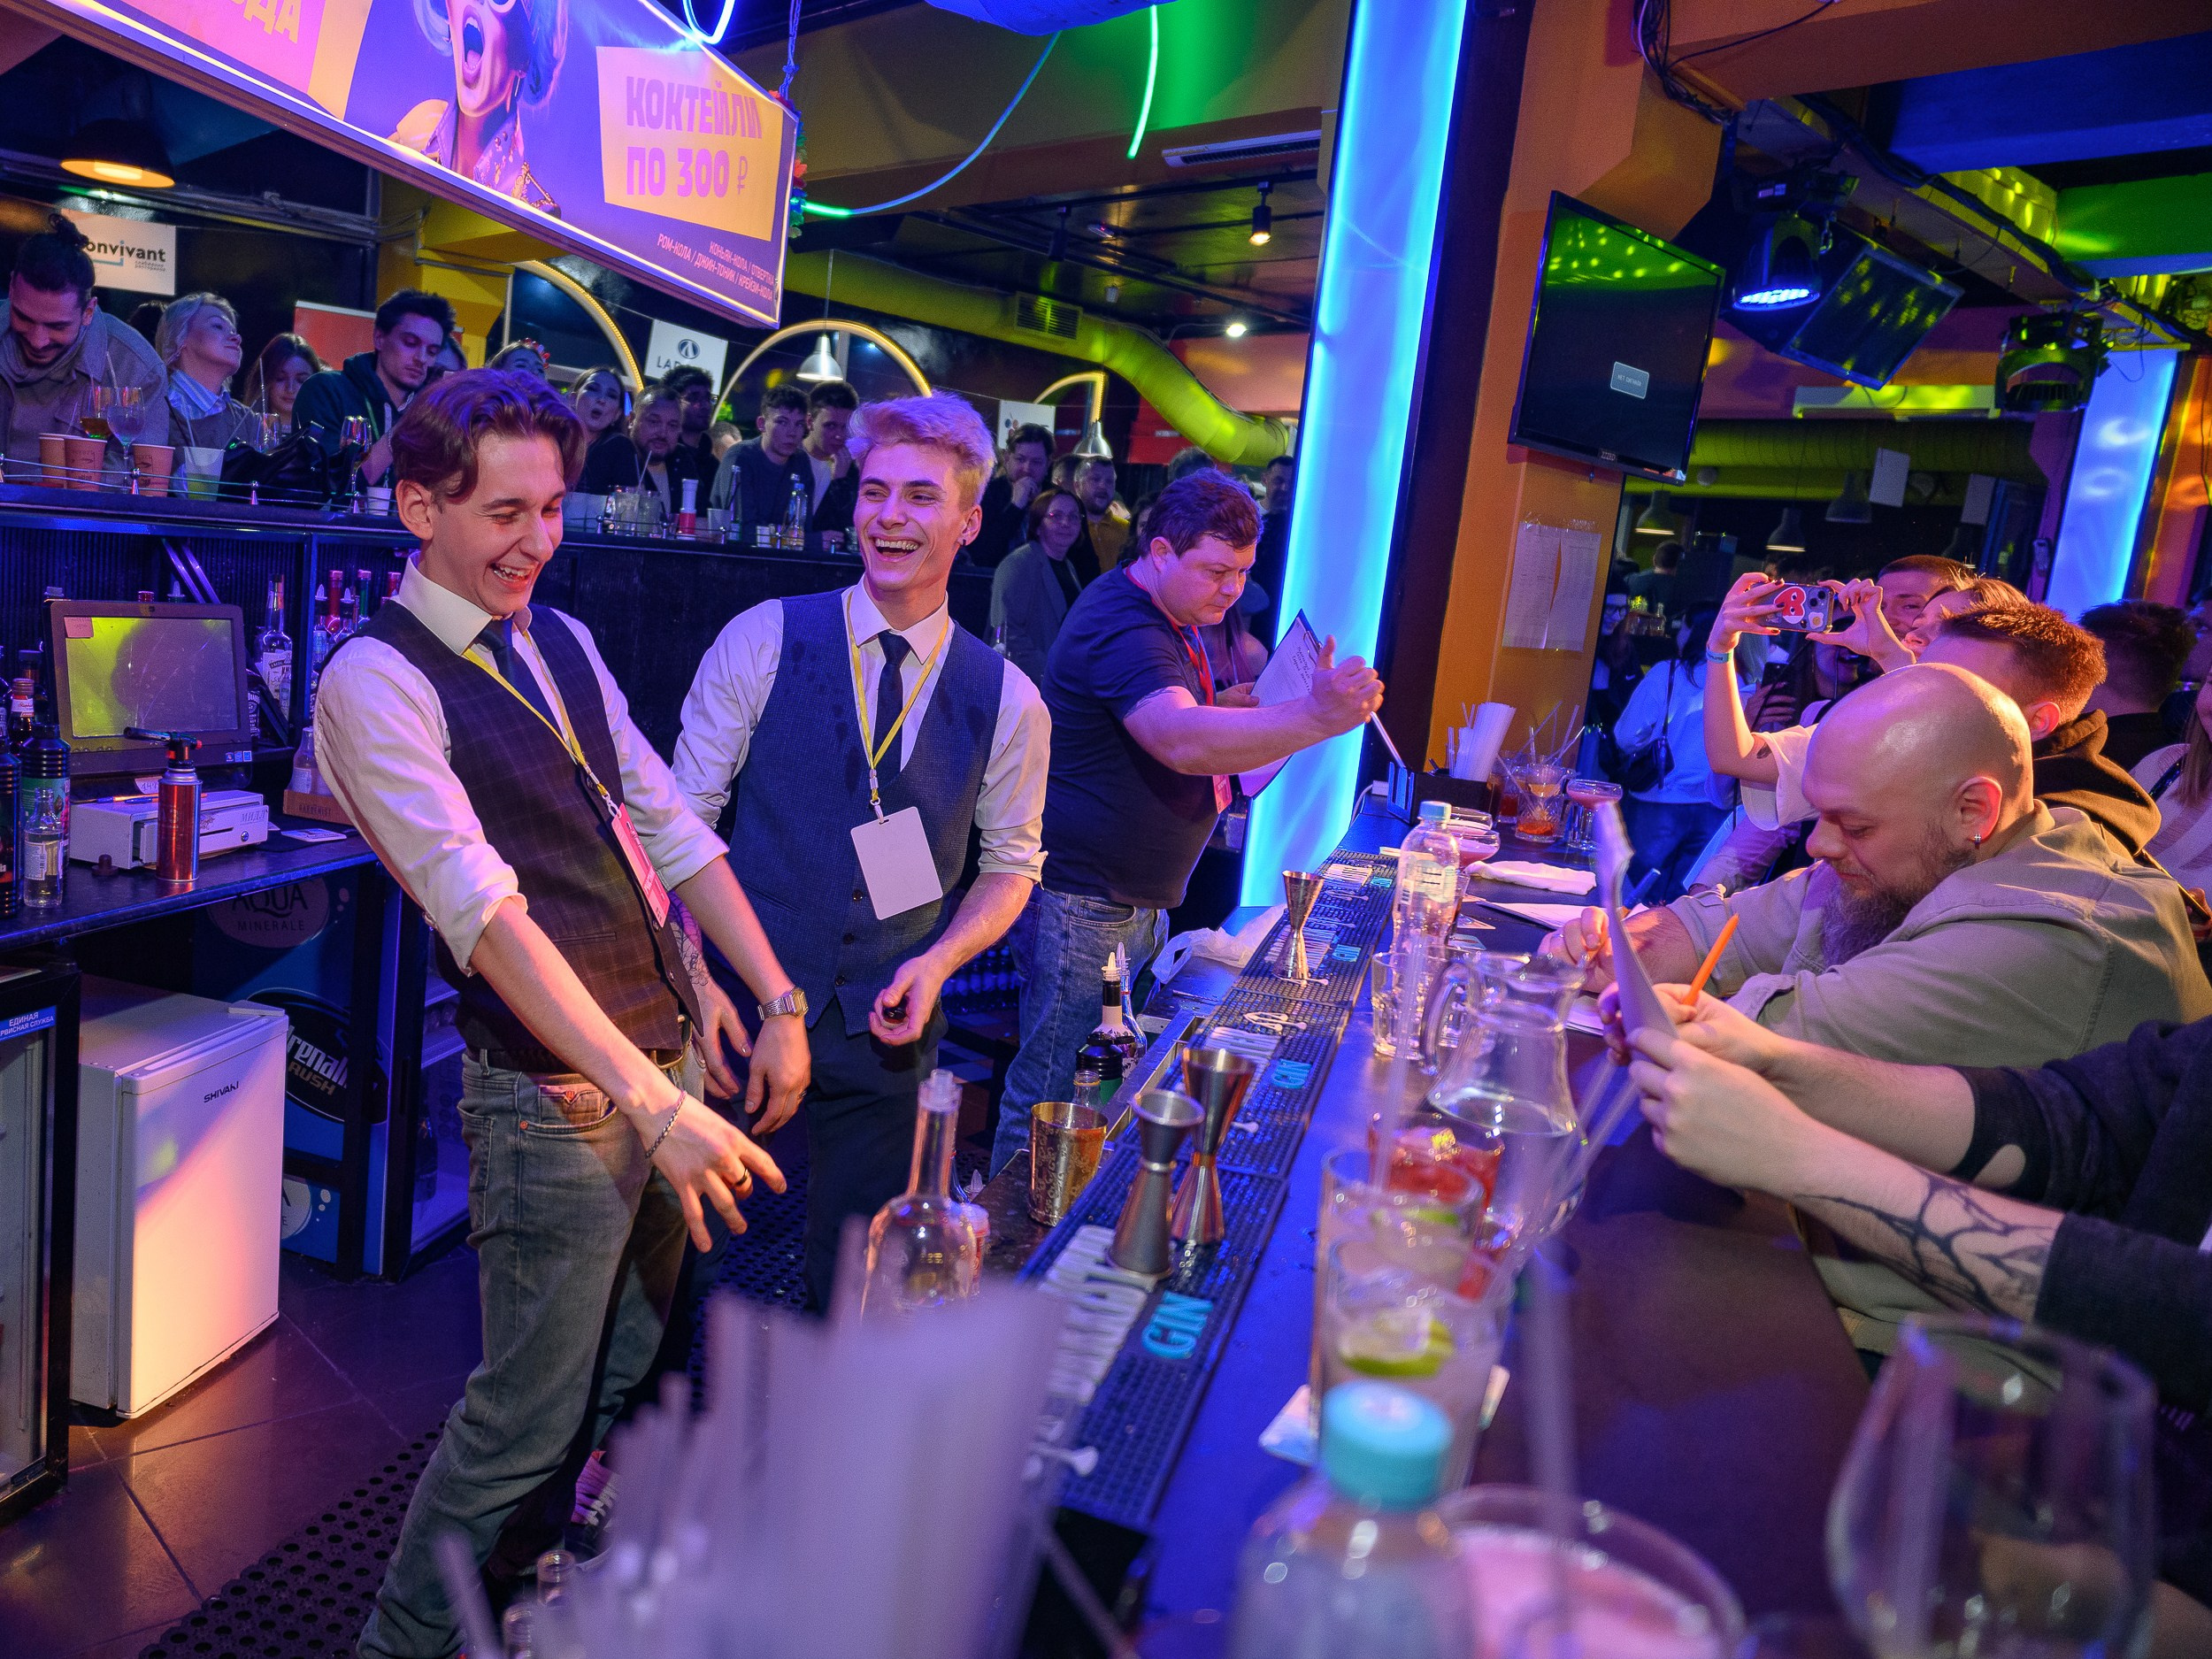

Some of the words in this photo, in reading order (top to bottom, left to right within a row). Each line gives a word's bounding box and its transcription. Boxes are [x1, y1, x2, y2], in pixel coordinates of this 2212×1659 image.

[626, 76, 763, 139] КОКТЕЙЛИ
[626, 146, 666, 196] ПО
[677, 148, 730, 198] 300
[86, 240, 165, 263] onvivant
[657, 233, 692, 262] РОМ-КОЛА
[694, 252, 736, 283] ДЖИН-ТОНИК
[237, 919, 304, 932] MINERALE
[9, 1011, 39, 1027] ЕДИНАЯ
[29, 1015, 54, 1028] СЛУЖБА
[288, 1061, 336, 1096] RUSH
[1271, 1059, 1312, 1089] GIN
[1141, 1290, 1213, 1360] GIN
